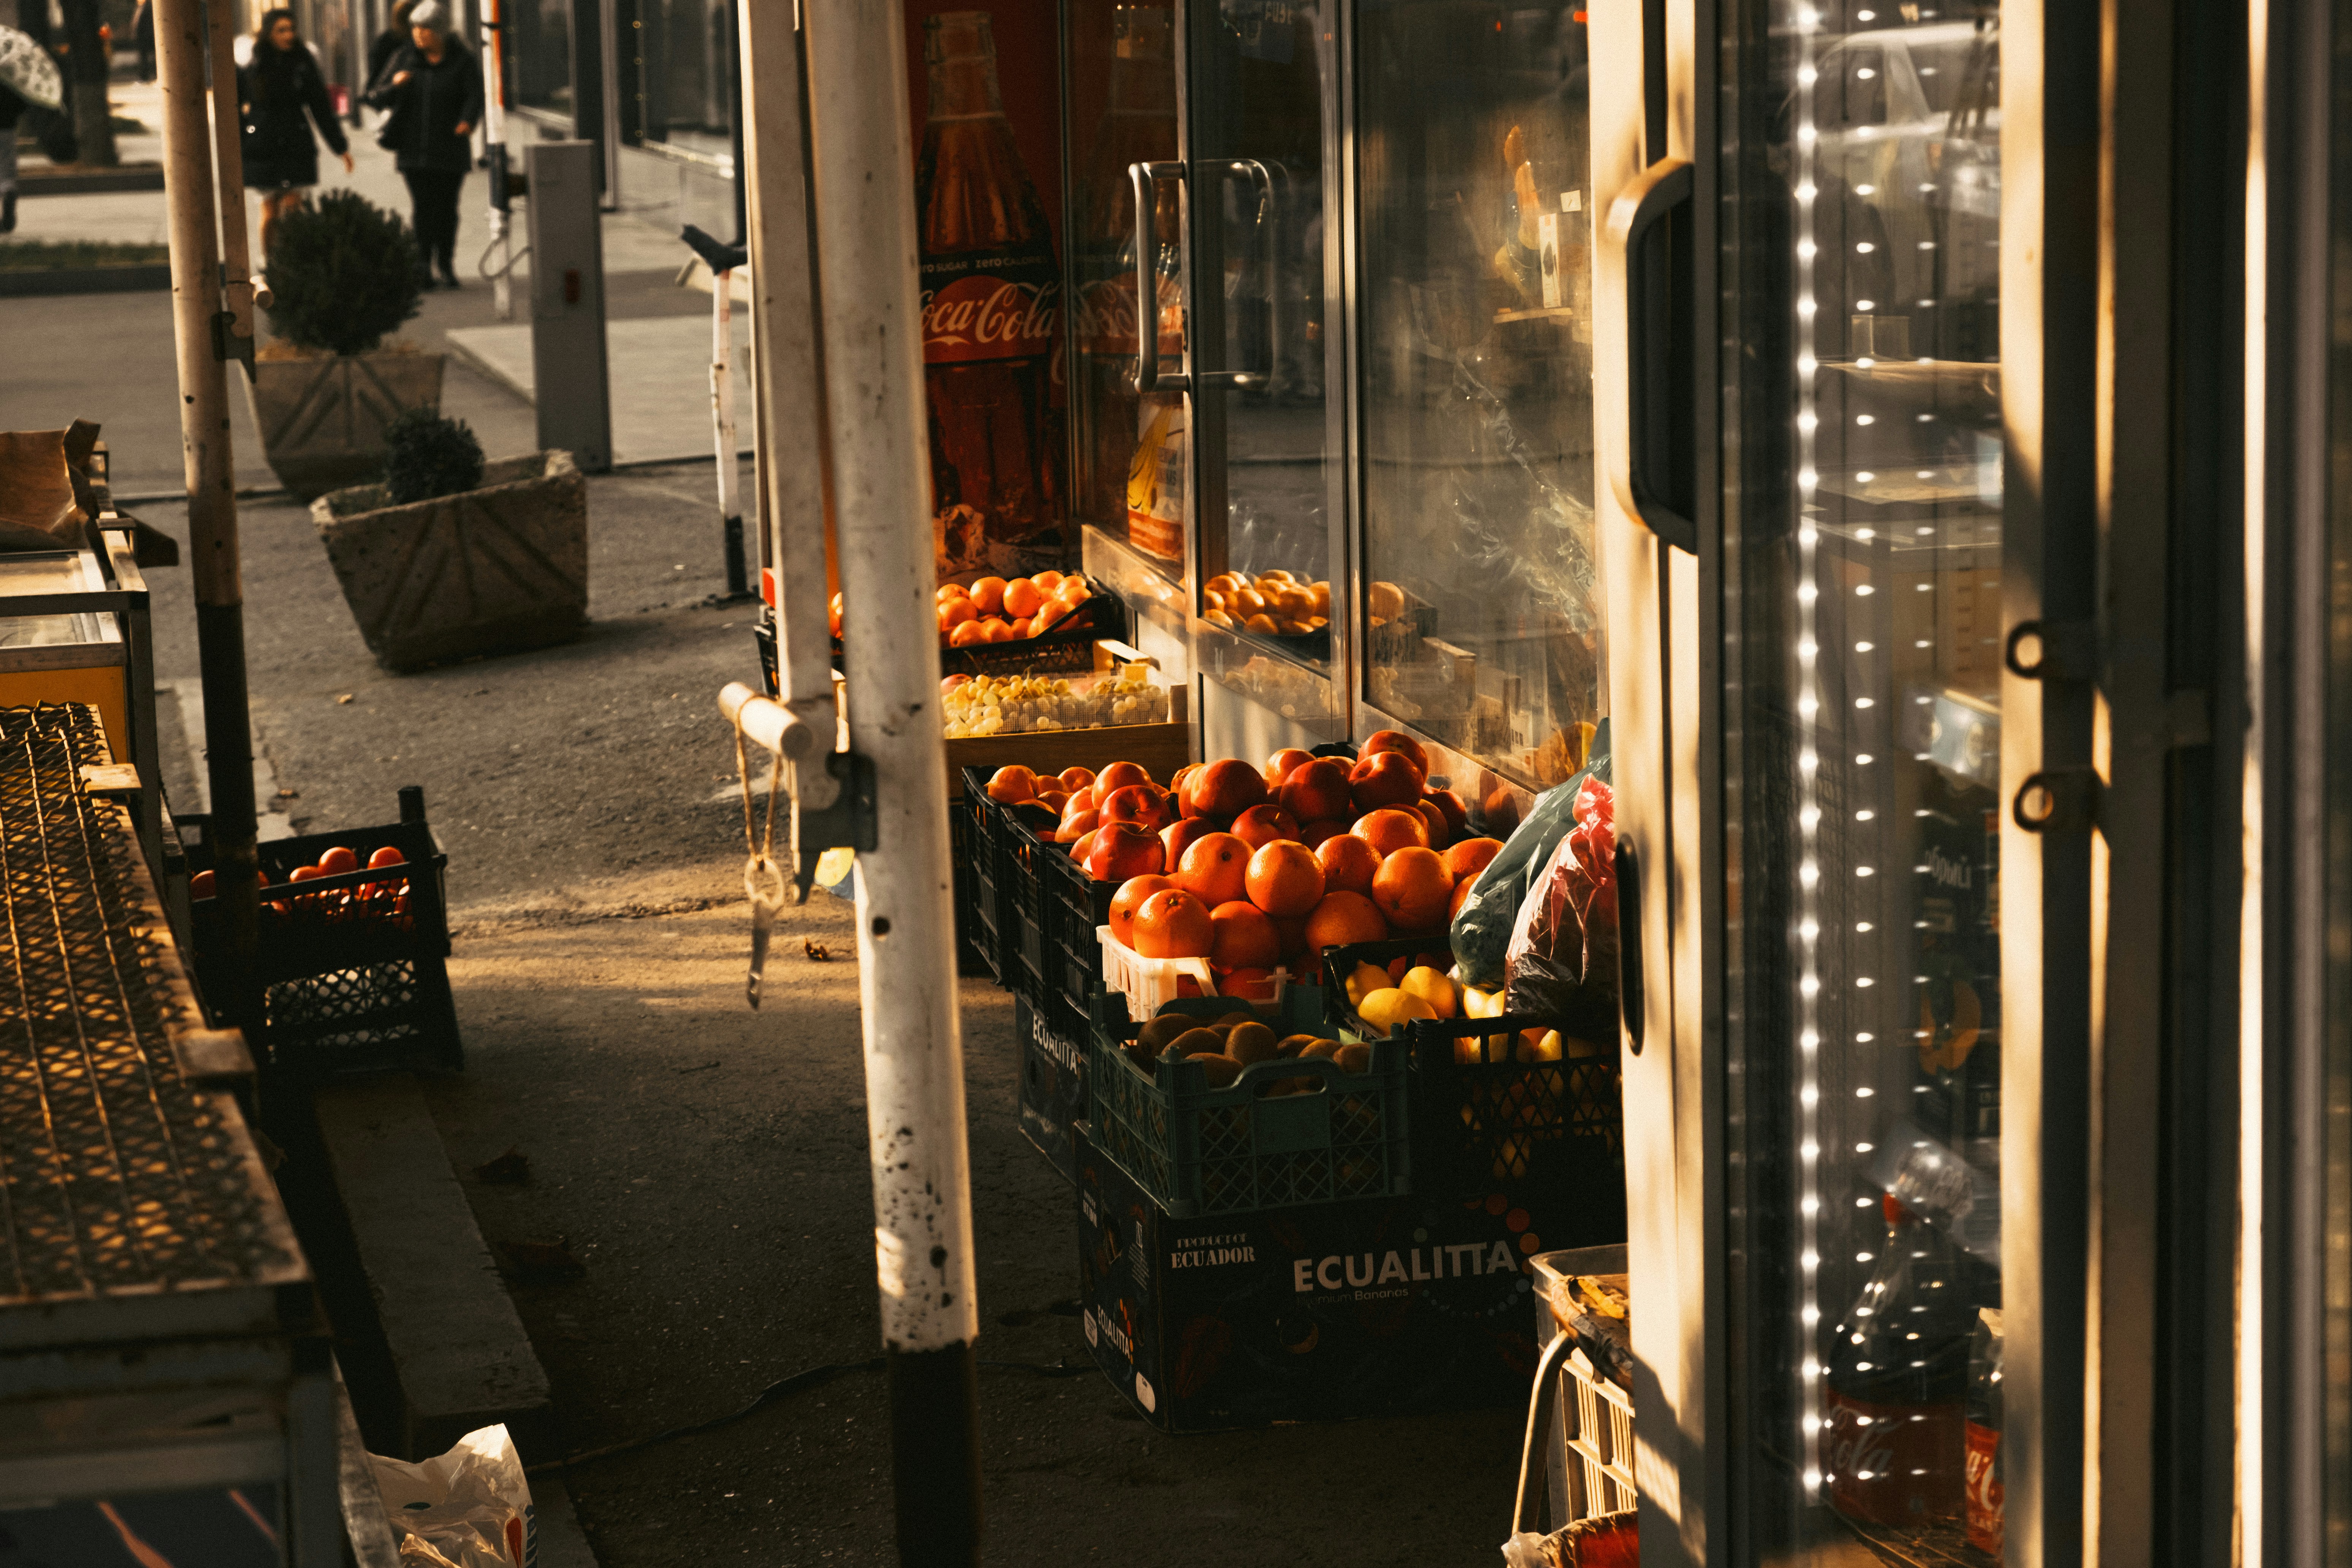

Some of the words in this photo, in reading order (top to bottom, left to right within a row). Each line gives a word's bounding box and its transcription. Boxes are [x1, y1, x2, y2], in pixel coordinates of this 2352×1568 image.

[976, 258, 1002, 269] zero
[1033, 1014, 1077, 1075] ECUALITTA
[1177, 1235, 1231, 1248] PRODUCT
[1171, 1246, 1256, 1269] ECUADOR
[1294, 1240, 1519, 1293] ECUALITTA
[1354, 1288, 1409, 1301] Bananas
[1098, 1303, 1130, 1361] ECUALITTA
